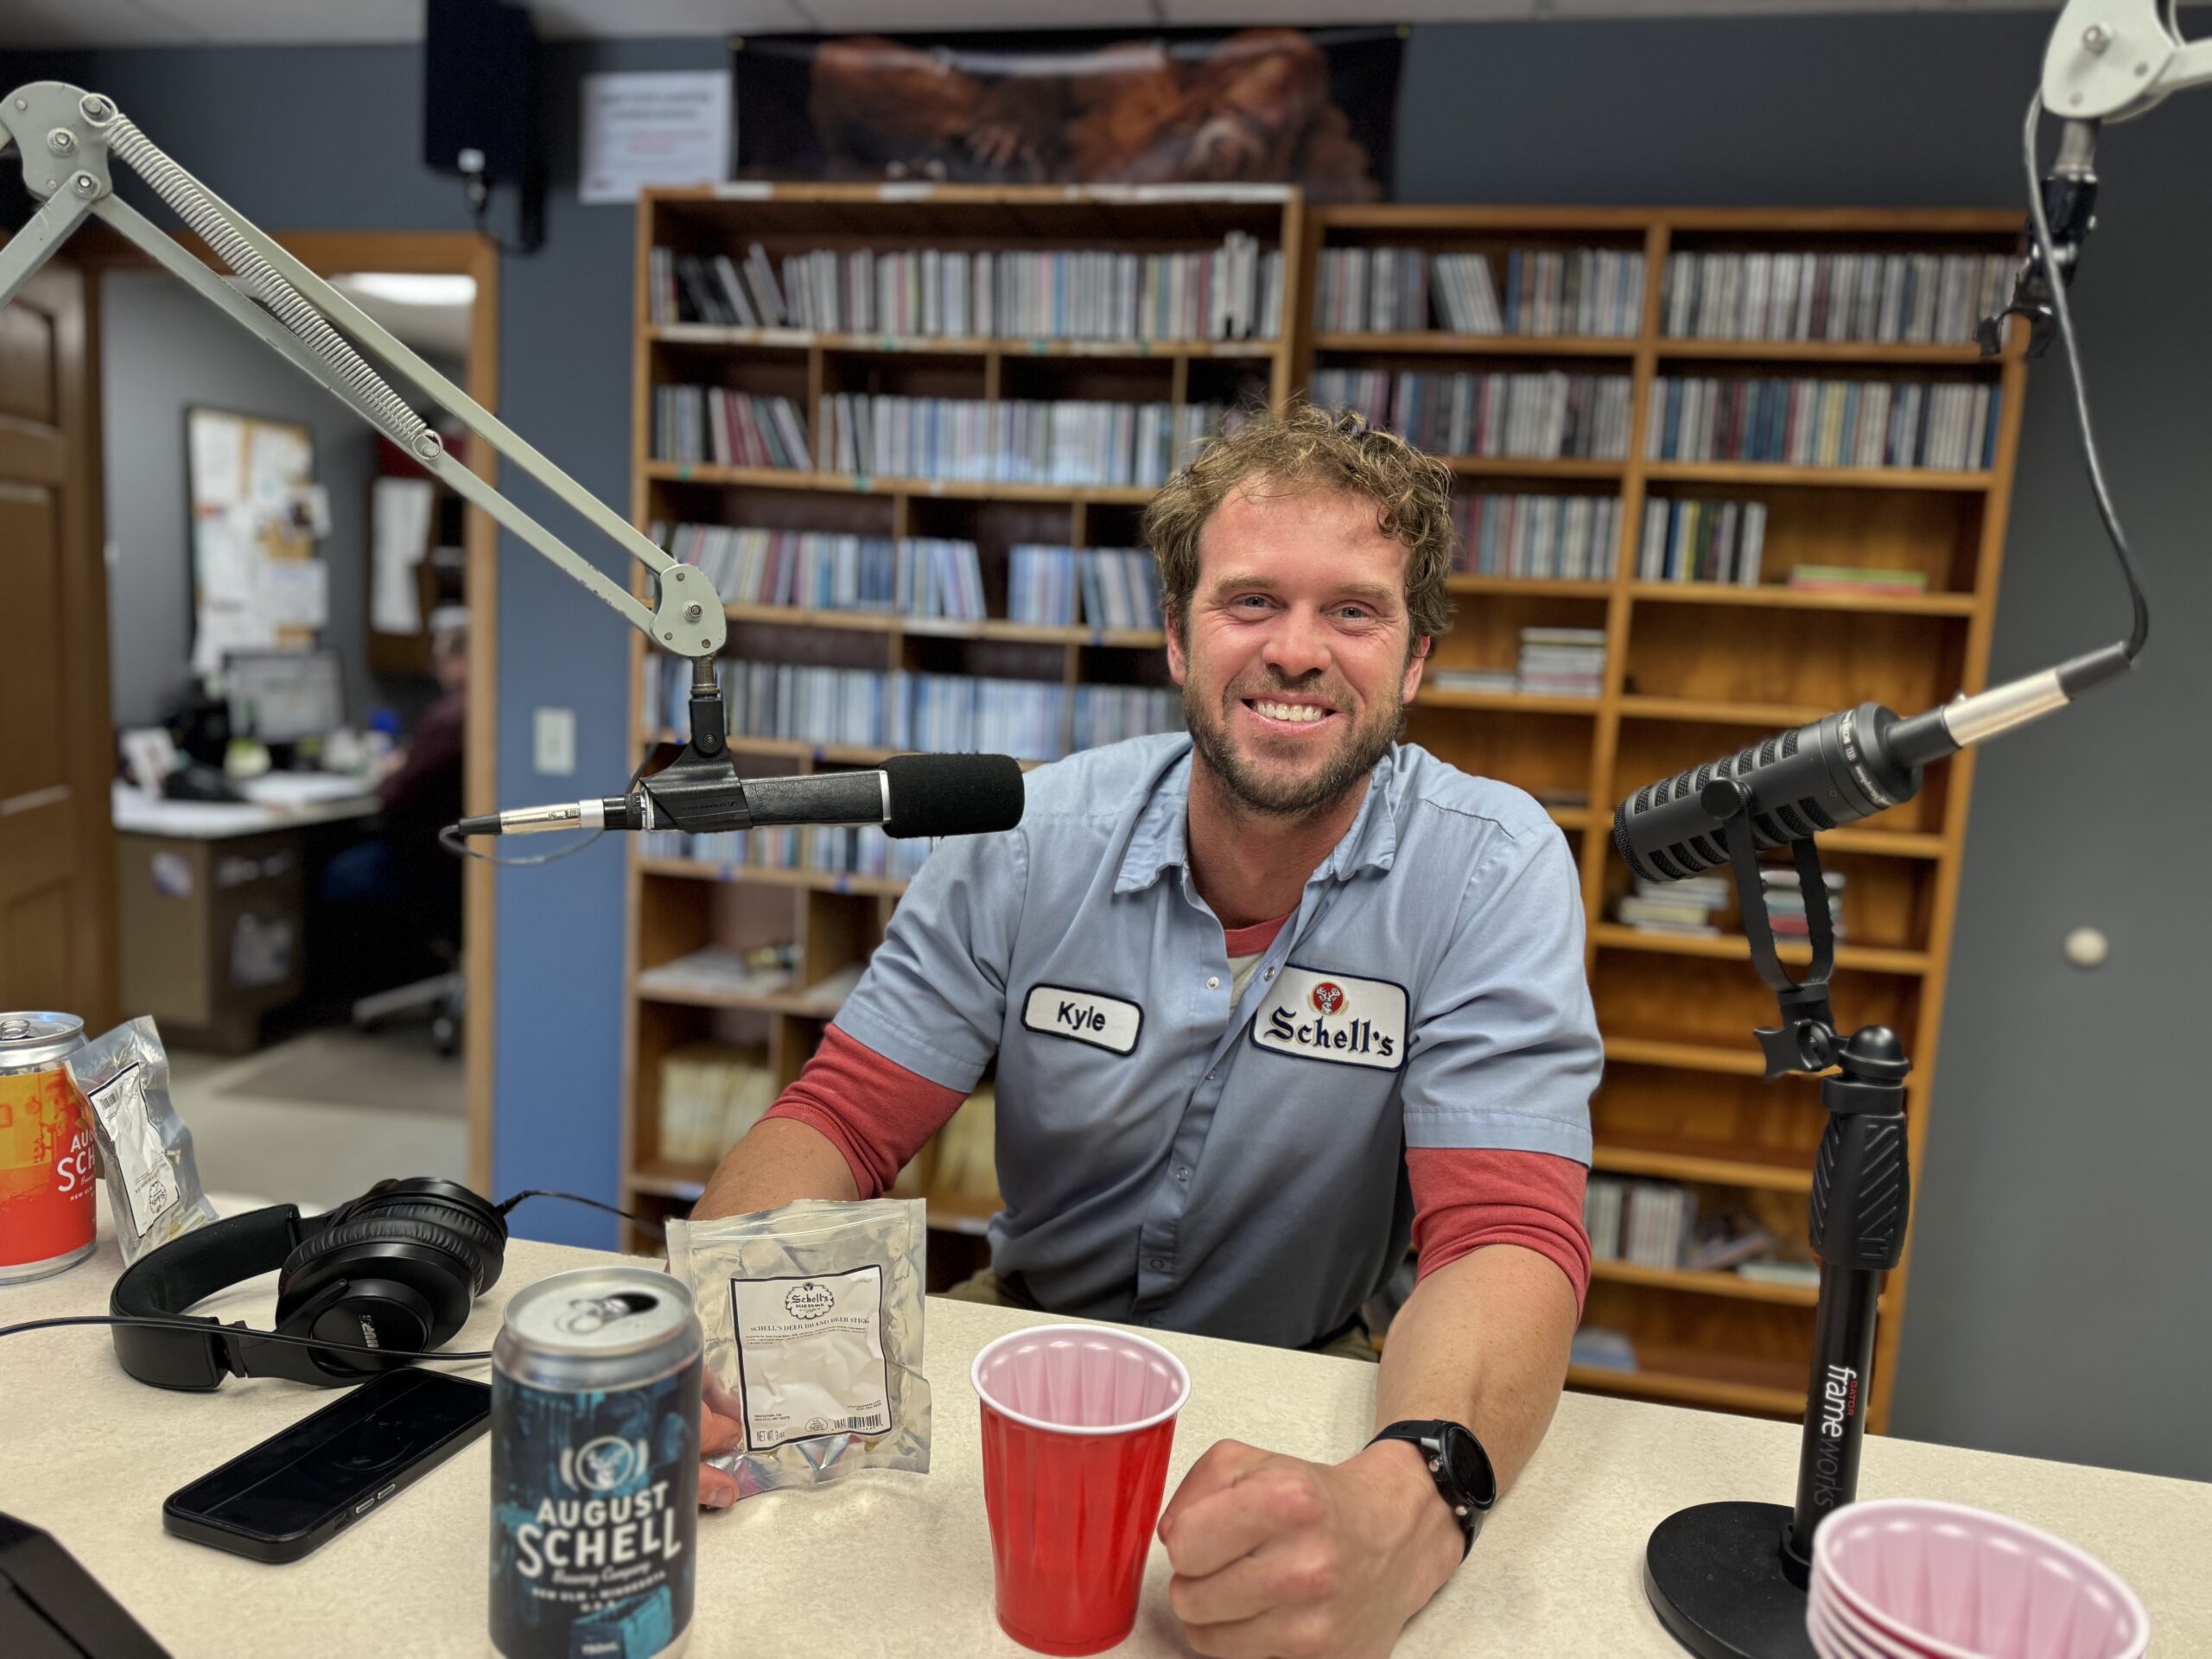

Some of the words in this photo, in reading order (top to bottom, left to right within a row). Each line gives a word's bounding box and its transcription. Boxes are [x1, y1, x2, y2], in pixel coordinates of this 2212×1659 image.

[1057, 1001, 1106, 1032] Kyle
[1264, 1006, 1395, 1058] Schell's
[791, 1293, 829, 1303] Schell's
[359, 1314, 379, 1348] HURE
[804, 1319, 830, 1329] BRAND
[1847, 1380, 1858, 1416] GATOR
[756, 1431, 766, 1442] NET
[536, 1480, 670, 1528] AUGUST
[516, 1508, 683, 1579] SCHELL
